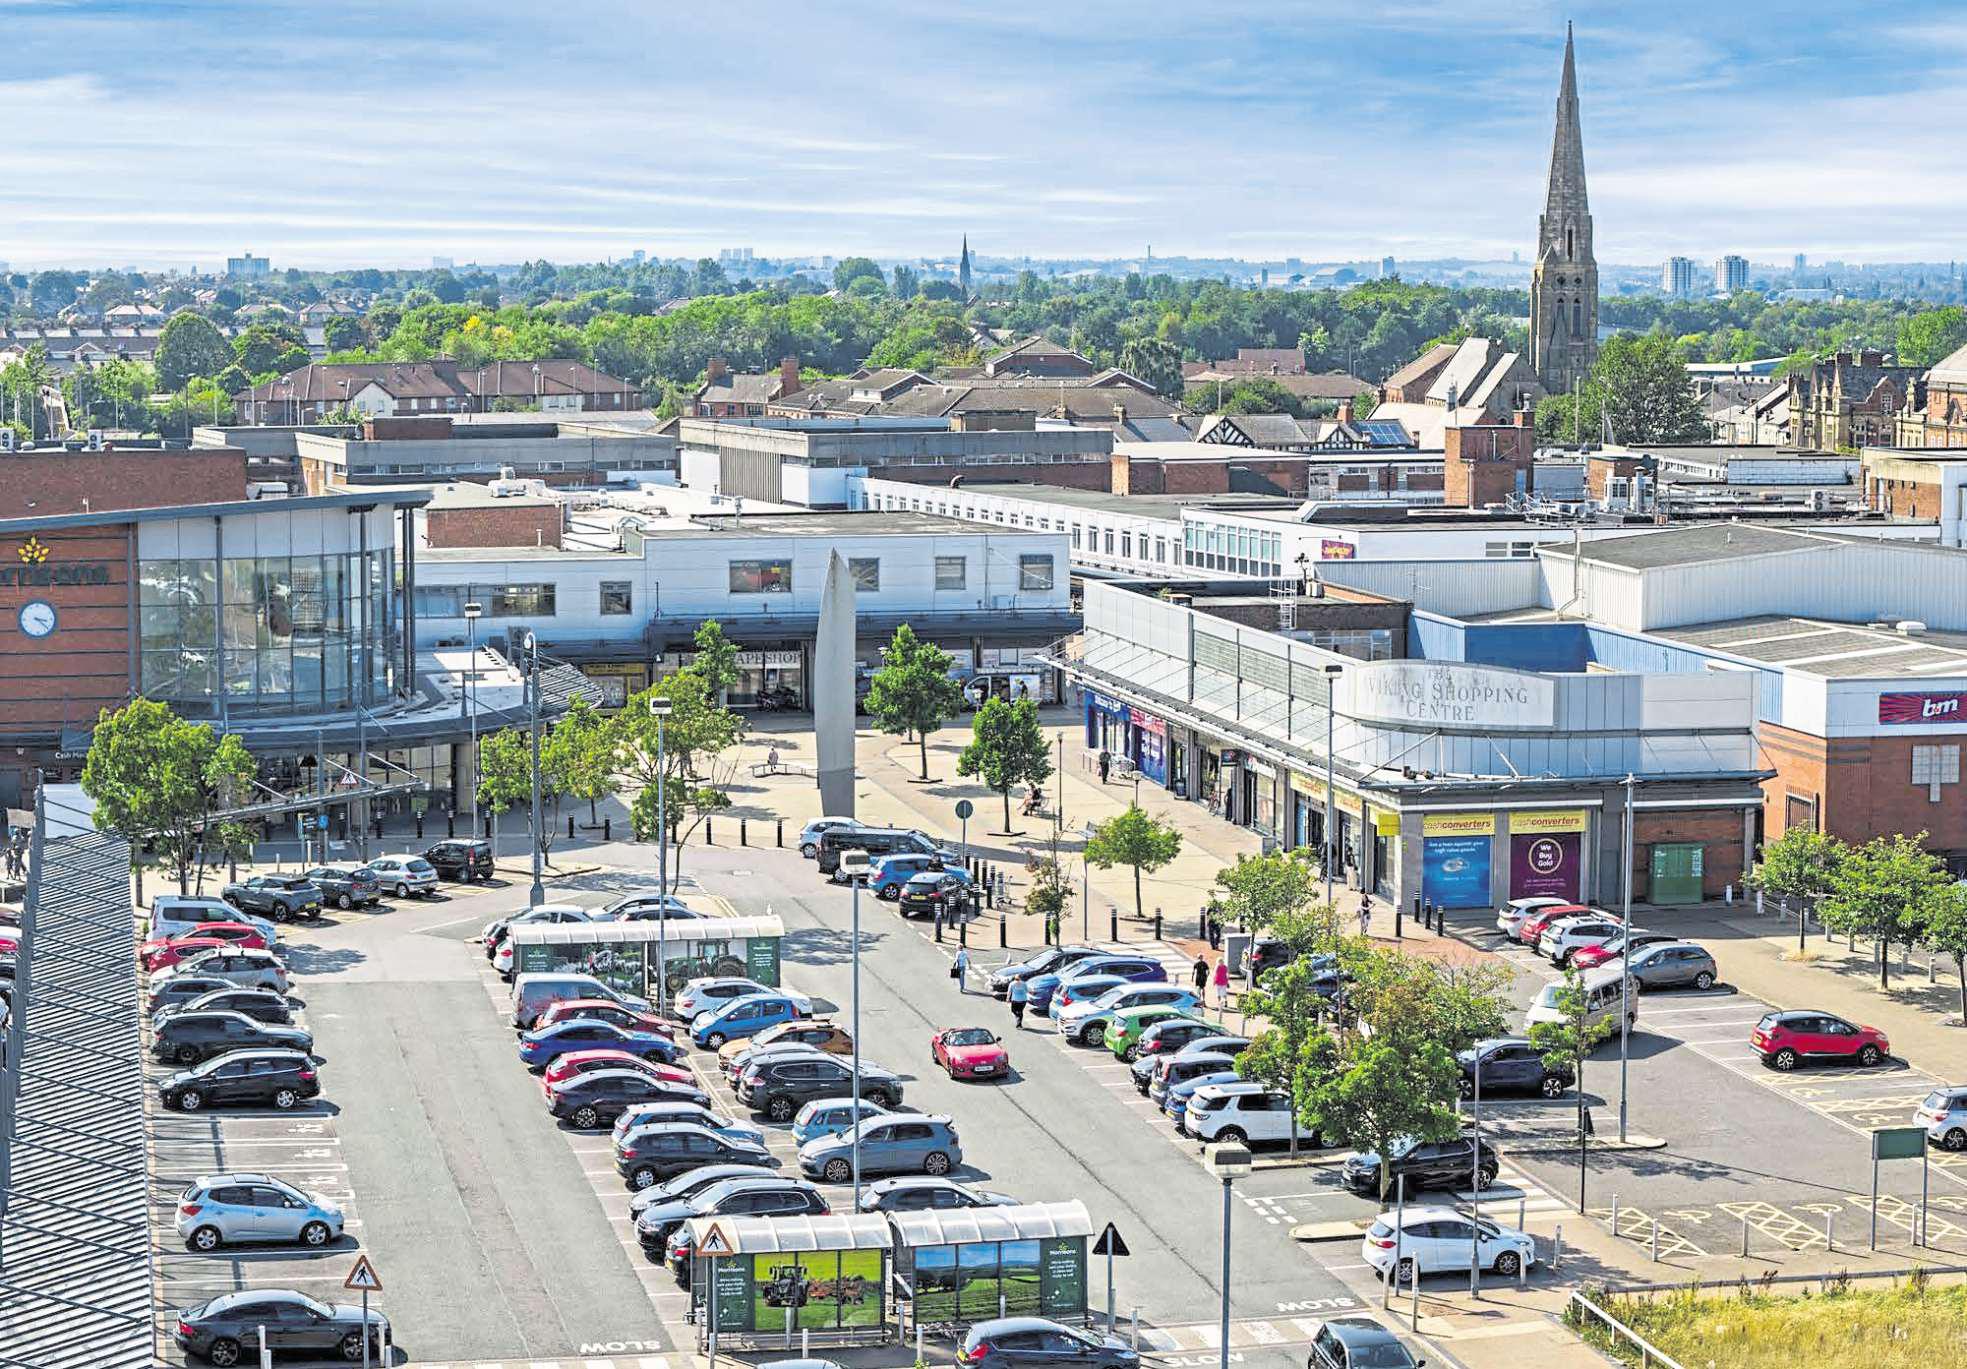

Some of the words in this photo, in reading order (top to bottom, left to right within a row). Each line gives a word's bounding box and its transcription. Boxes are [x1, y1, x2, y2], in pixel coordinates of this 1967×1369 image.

[765, 653, 800, 664] SHOP
[1368, 678, 1422, 699] VIKING
[1432, 682, 1528, 704] SHOPPING
[1406, 700, 1474, 721] CENTRE
[1539, 852, 1552, 860] Buy
[1277, 1297, 1355, 1311] SLOW
[580, 1341, 660, 1353] SLOW
